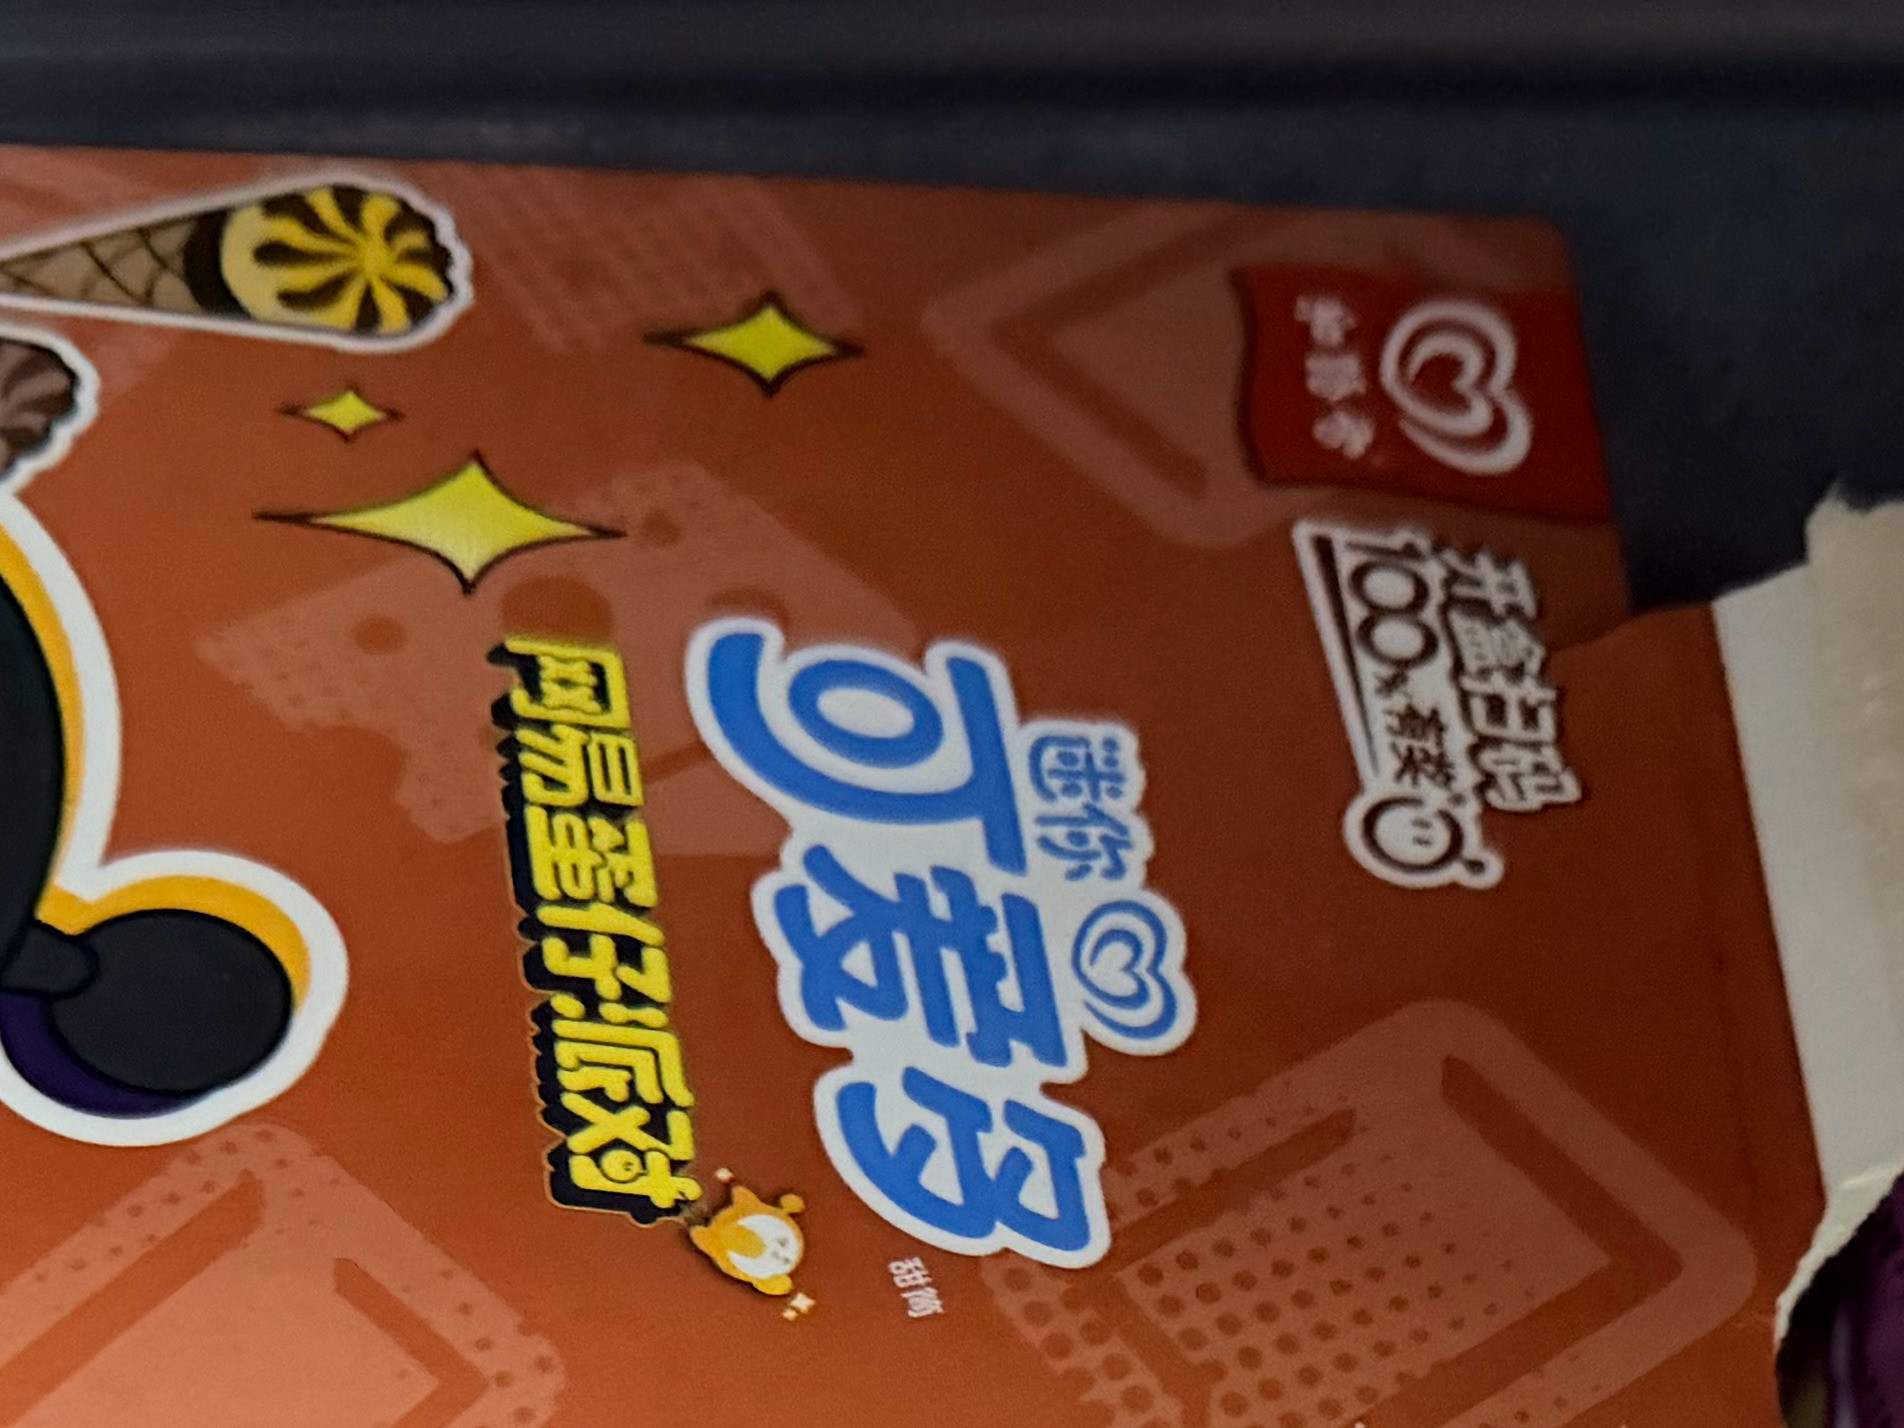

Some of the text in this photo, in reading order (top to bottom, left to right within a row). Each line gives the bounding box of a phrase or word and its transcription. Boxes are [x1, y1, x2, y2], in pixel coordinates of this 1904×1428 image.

[1027, 733, 1134, 882] 迷你
[1441, 548, 1584, 812] 开盒扫码
[504, 635, 704, 1212] 网易蛋仔派对
[706, 630, 1093, 1254] 可爱多
[887, 1256, 946, 1319] 甜筒
